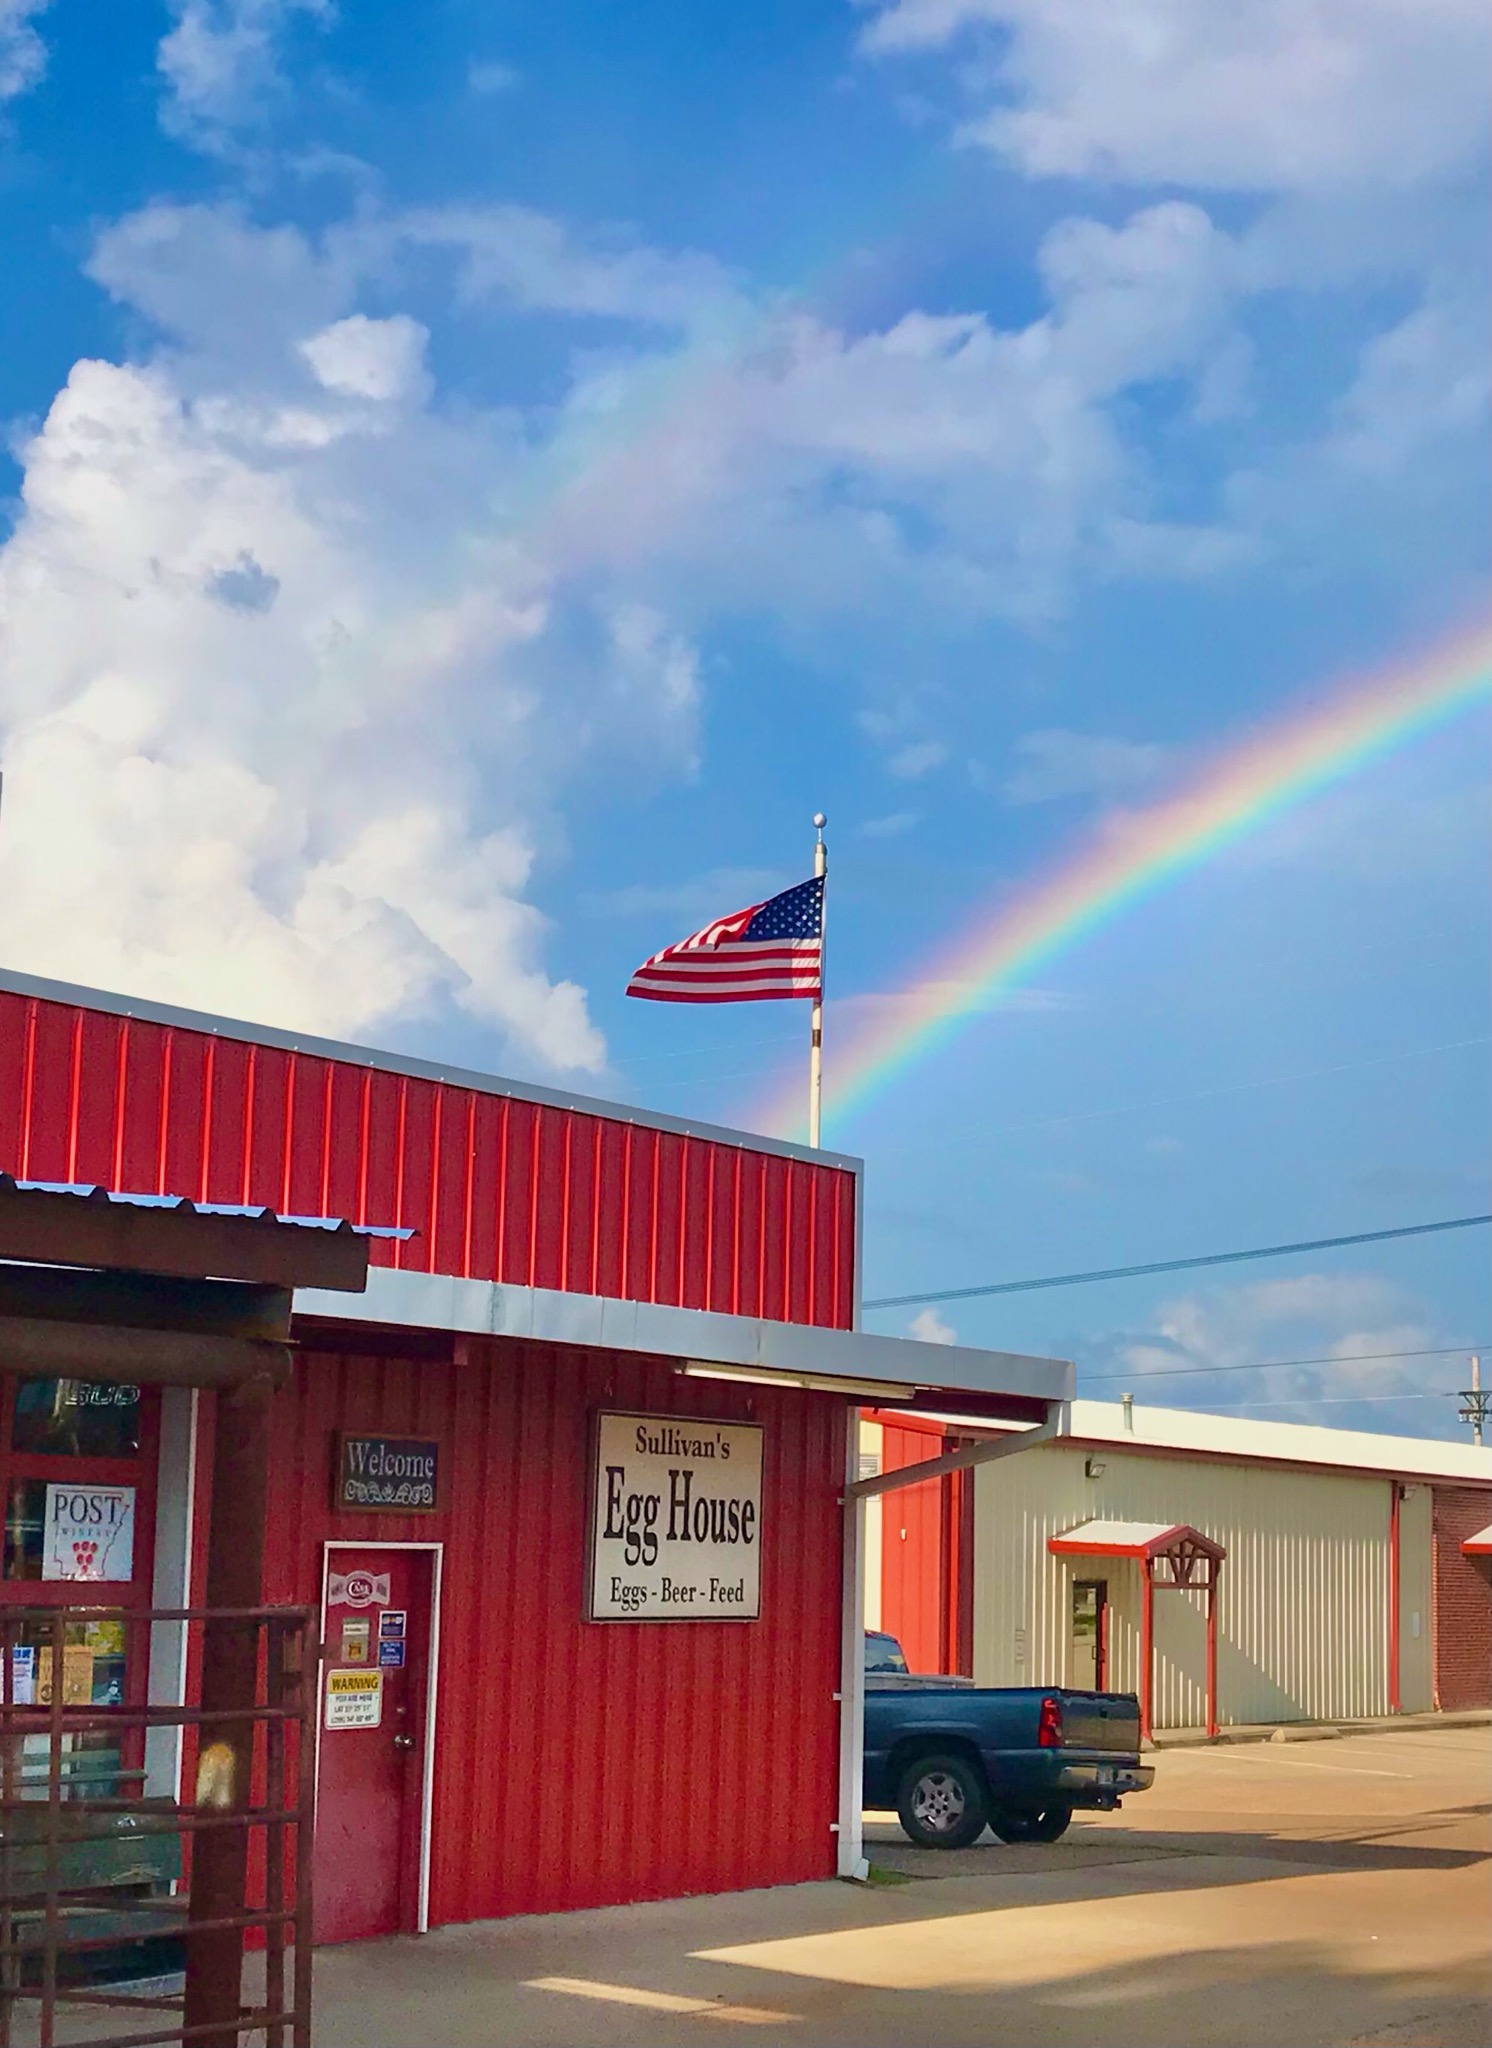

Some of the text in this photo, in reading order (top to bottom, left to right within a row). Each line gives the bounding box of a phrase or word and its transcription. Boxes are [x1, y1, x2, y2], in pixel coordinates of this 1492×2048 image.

[346, 1441, 434, 1479] Welcome
[635, 1425, 730, 1460] Sullivan's
[53, 1493, 122, 1525] POST
[603, 1466, 755, 1567] Egg House
[610, 1577, 647, 1612] Eggs
[661, 1577, 697, 1603] Beer
[709, 1578, 744, 1603] Feed
[332, 1676, 379, 1691] WARNING
